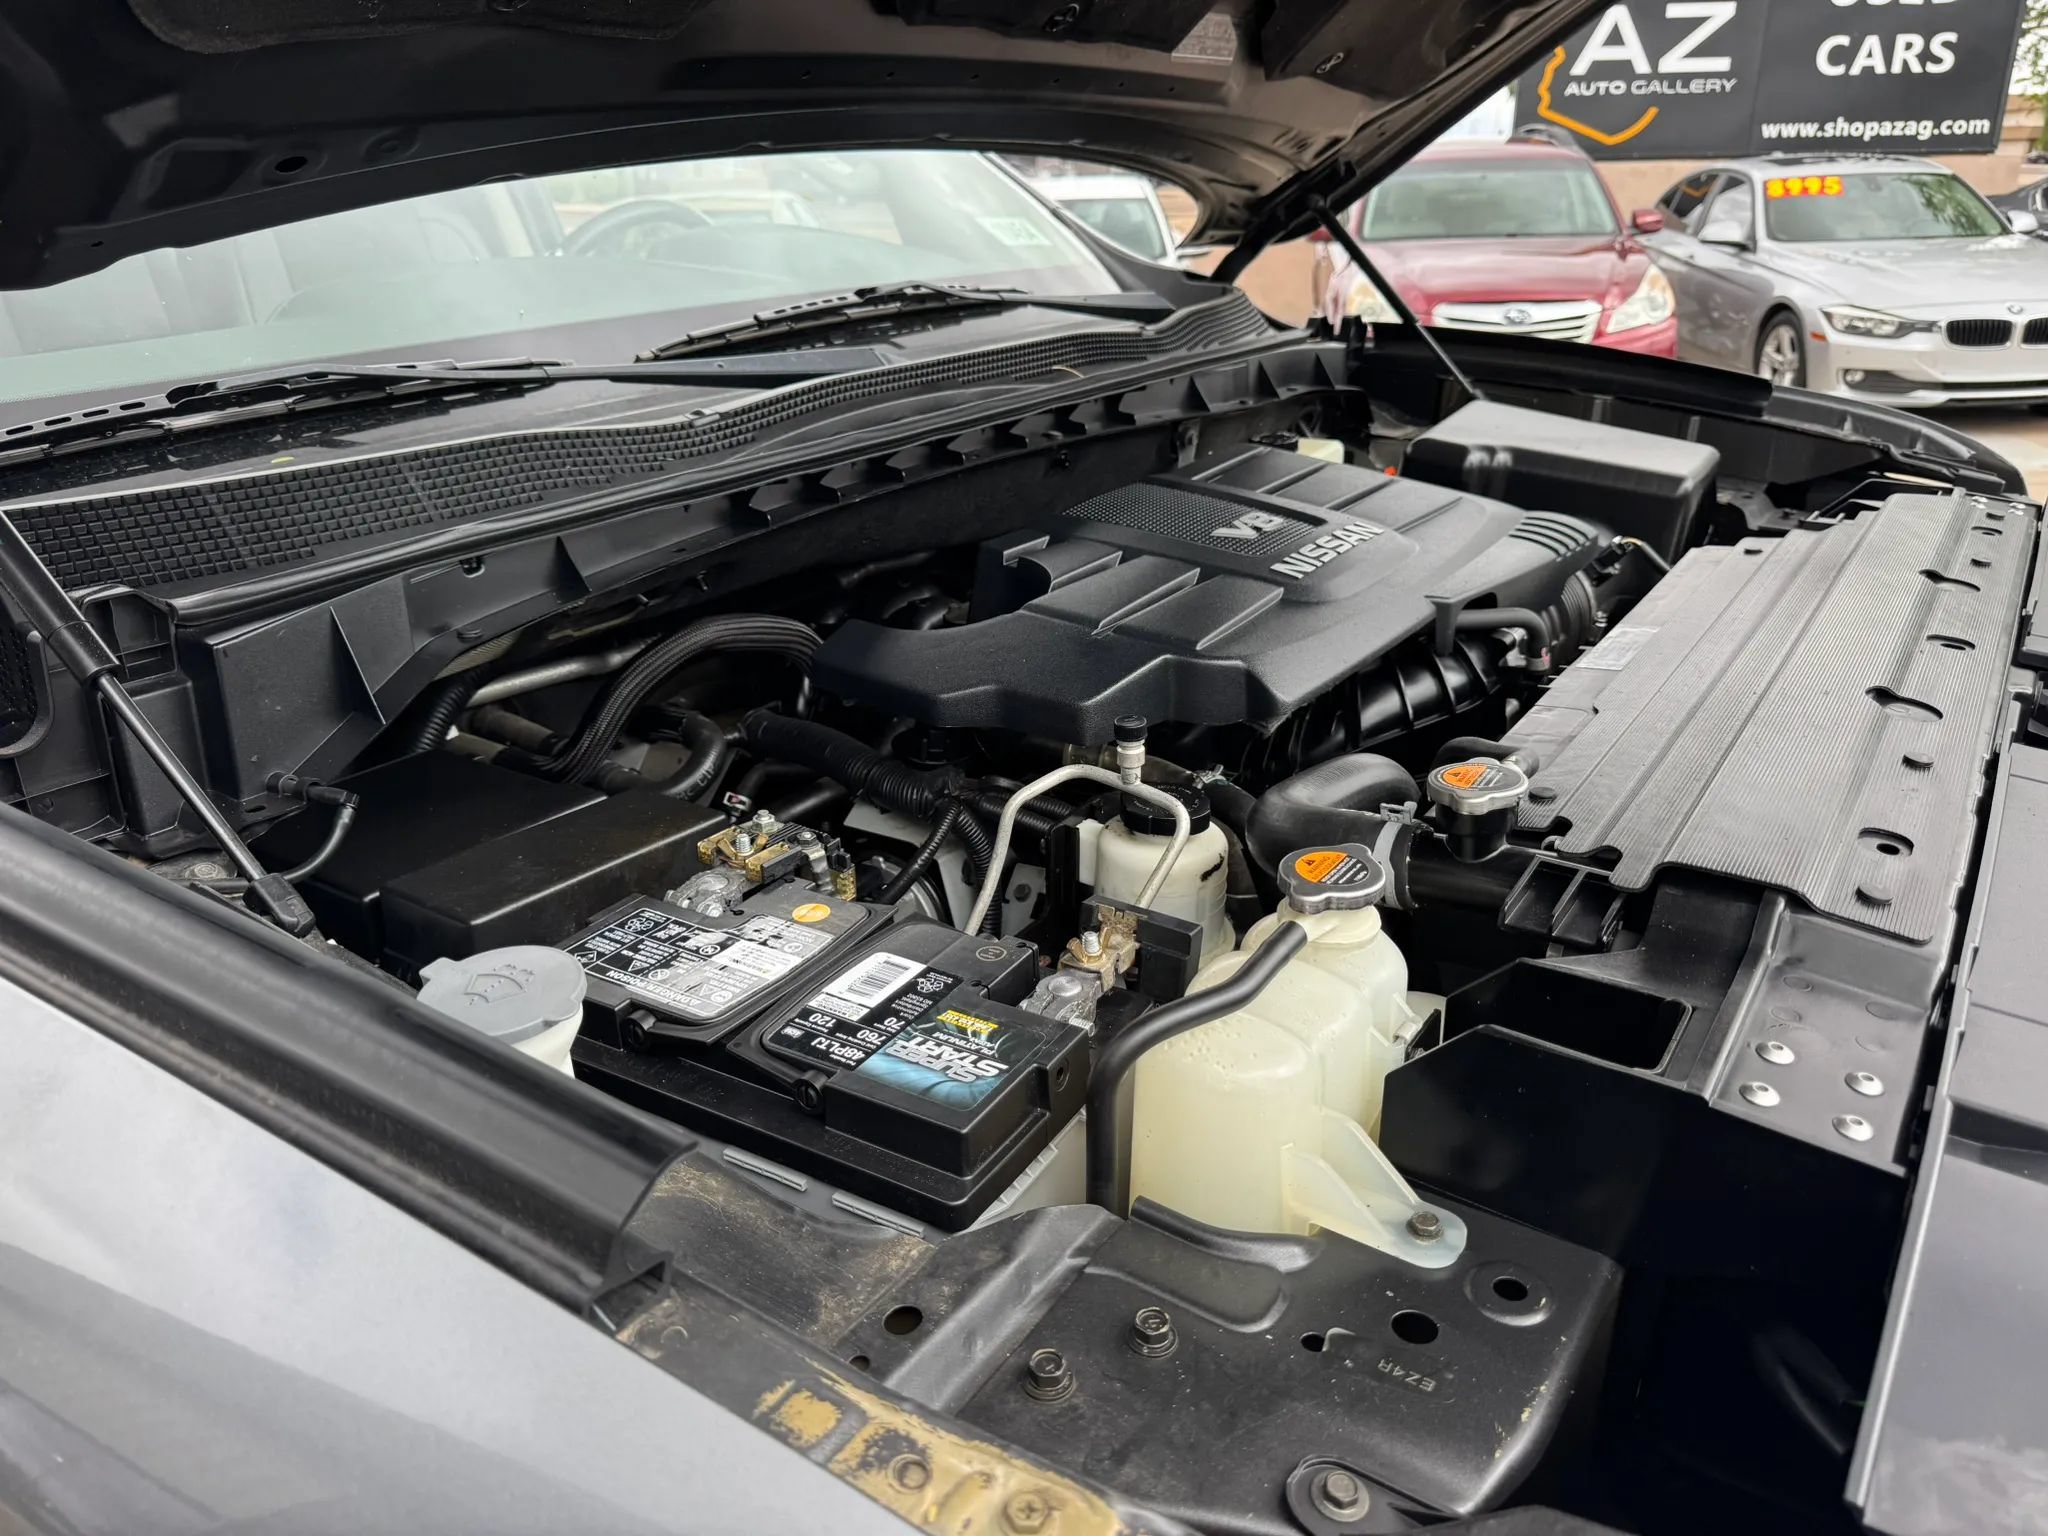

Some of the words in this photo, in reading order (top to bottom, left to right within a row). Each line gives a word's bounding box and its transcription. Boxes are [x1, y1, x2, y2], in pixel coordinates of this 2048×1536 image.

[1569, 1, 1738, 76] AZ
[1815, 32, 1959, 77] CARS
[1564, 78, 1627, 97] AUTO
[1630, 77, 1738, 96] GALLERY
[1761, 117, 1991, 142] www.shopazag.com
[1270, 521, 1385, 579] NISSAN
[605, 970, 647, 989] POISON
[646, 982, 692, 1004] DANGER
[809, 1013, 836, 1028] 120
[884, 1017, 905, 1030] 70
[811, 1037, 865, 1060] 48PLTJ
[857, 1030, 886, 1045] 760
[932, 1032, 996, 1056] PLATINUM
[886, 1040, 977, 1083] SUPER
[900, 1036, 1009, 1077] START
